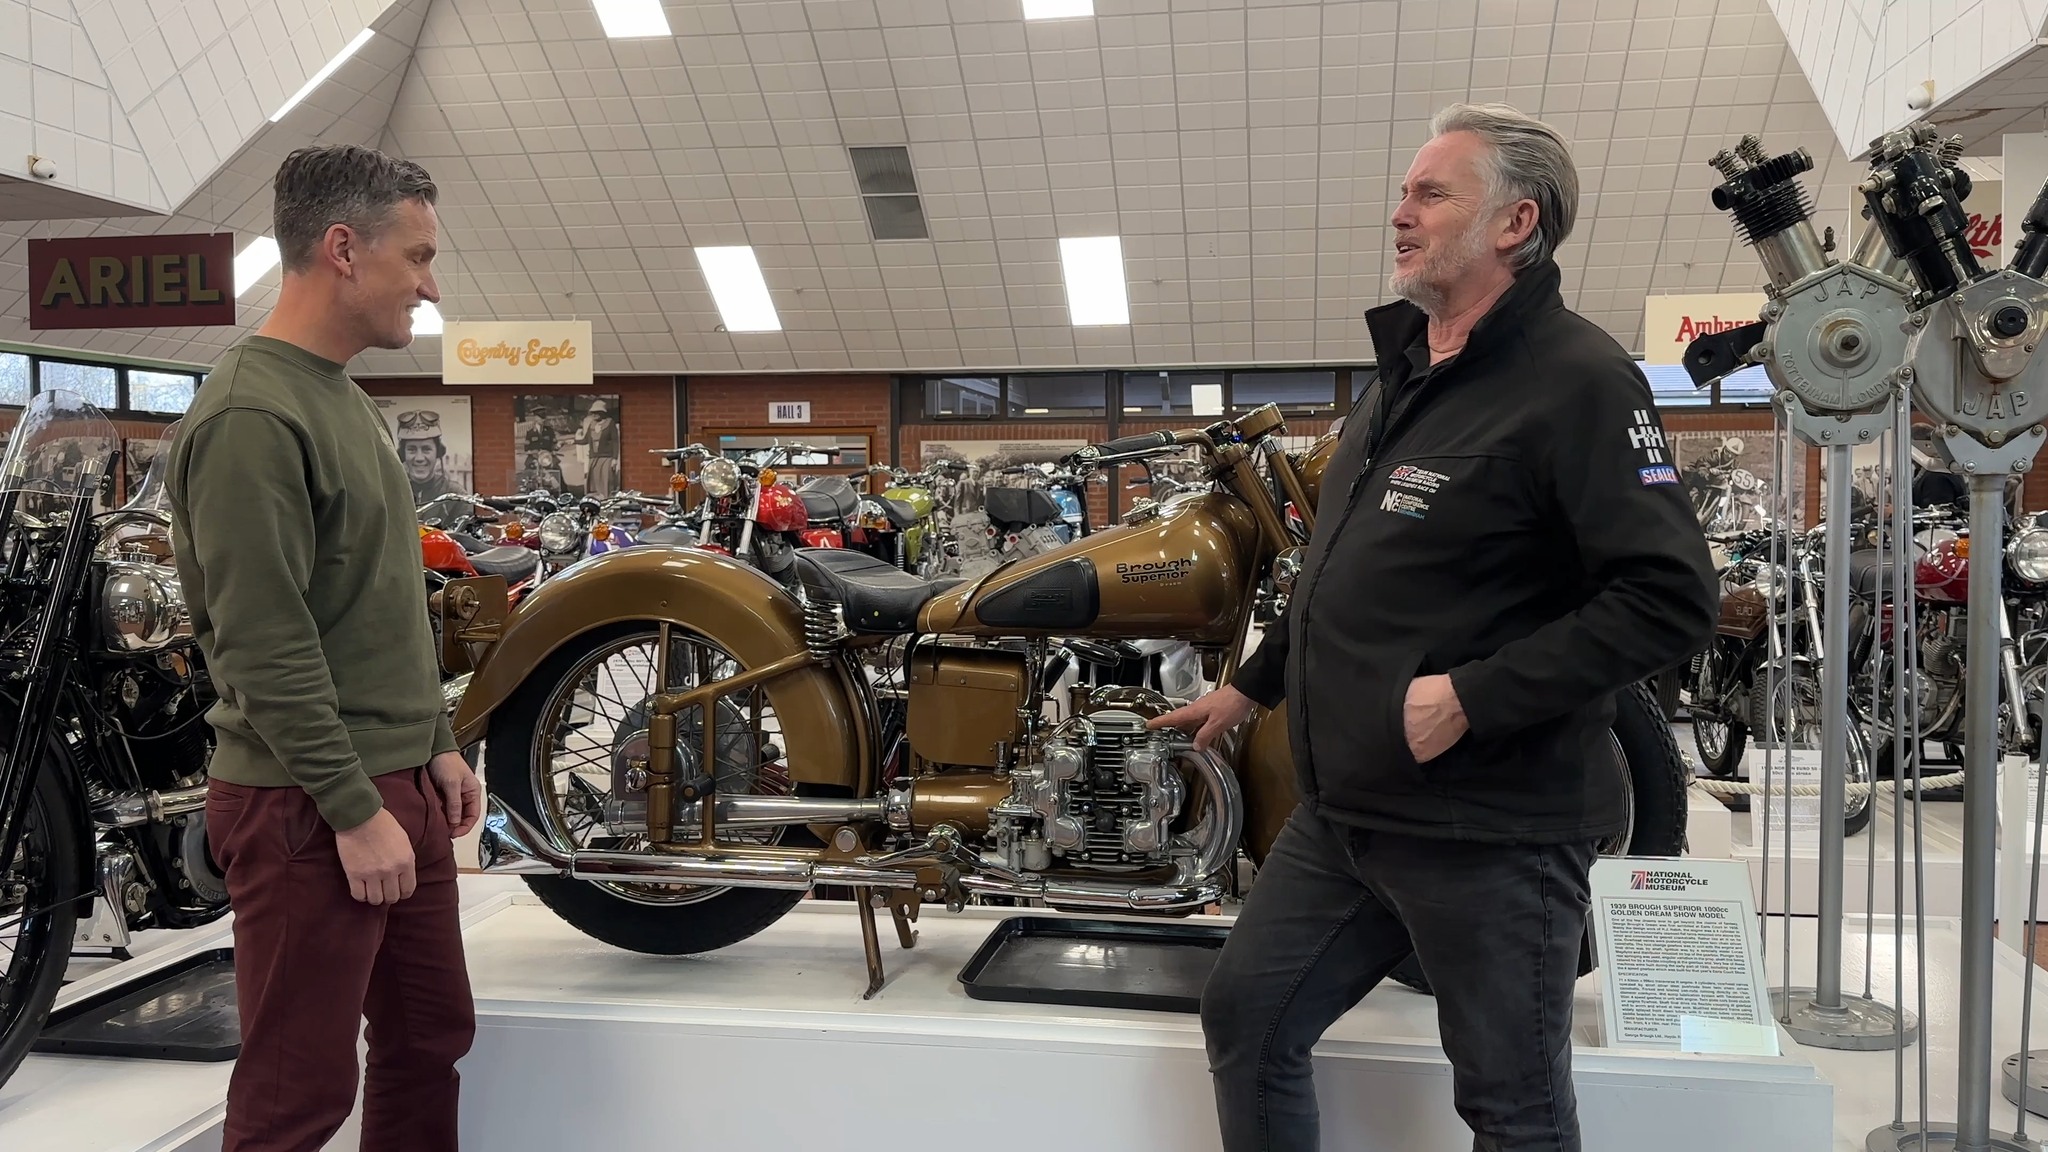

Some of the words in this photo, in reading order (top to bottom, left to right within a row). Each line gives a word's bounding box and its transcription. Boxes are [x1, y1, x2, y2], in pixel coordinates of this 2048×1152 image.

[40, 253, 221, 307] ARIEL
[1813, 277, 1880, 302] JAP
[1781, 348, 1841, 405] TOTTENHAM
[777, 405, 795, 419] HALL
[797, 405, 802, 419] 3
[1962, 390, 2030, 420] JAP
[1734, 470, 1752, 488] 55
[1116, 557, 1192, 574] Brough
[1121, 570, 1189, 585] Superior
[1645, 878, 1709, 886] MOTORCYCLE
[1646, 871, 1693, 879] NATIONAL
[1645, 884, 1686, 892] MUSEUM
[1610, 909, 1643, 917] GOLDEN
[1644, 910, 1672, 918] DREAM
[1673, 911, 1697, 919] SHOW
